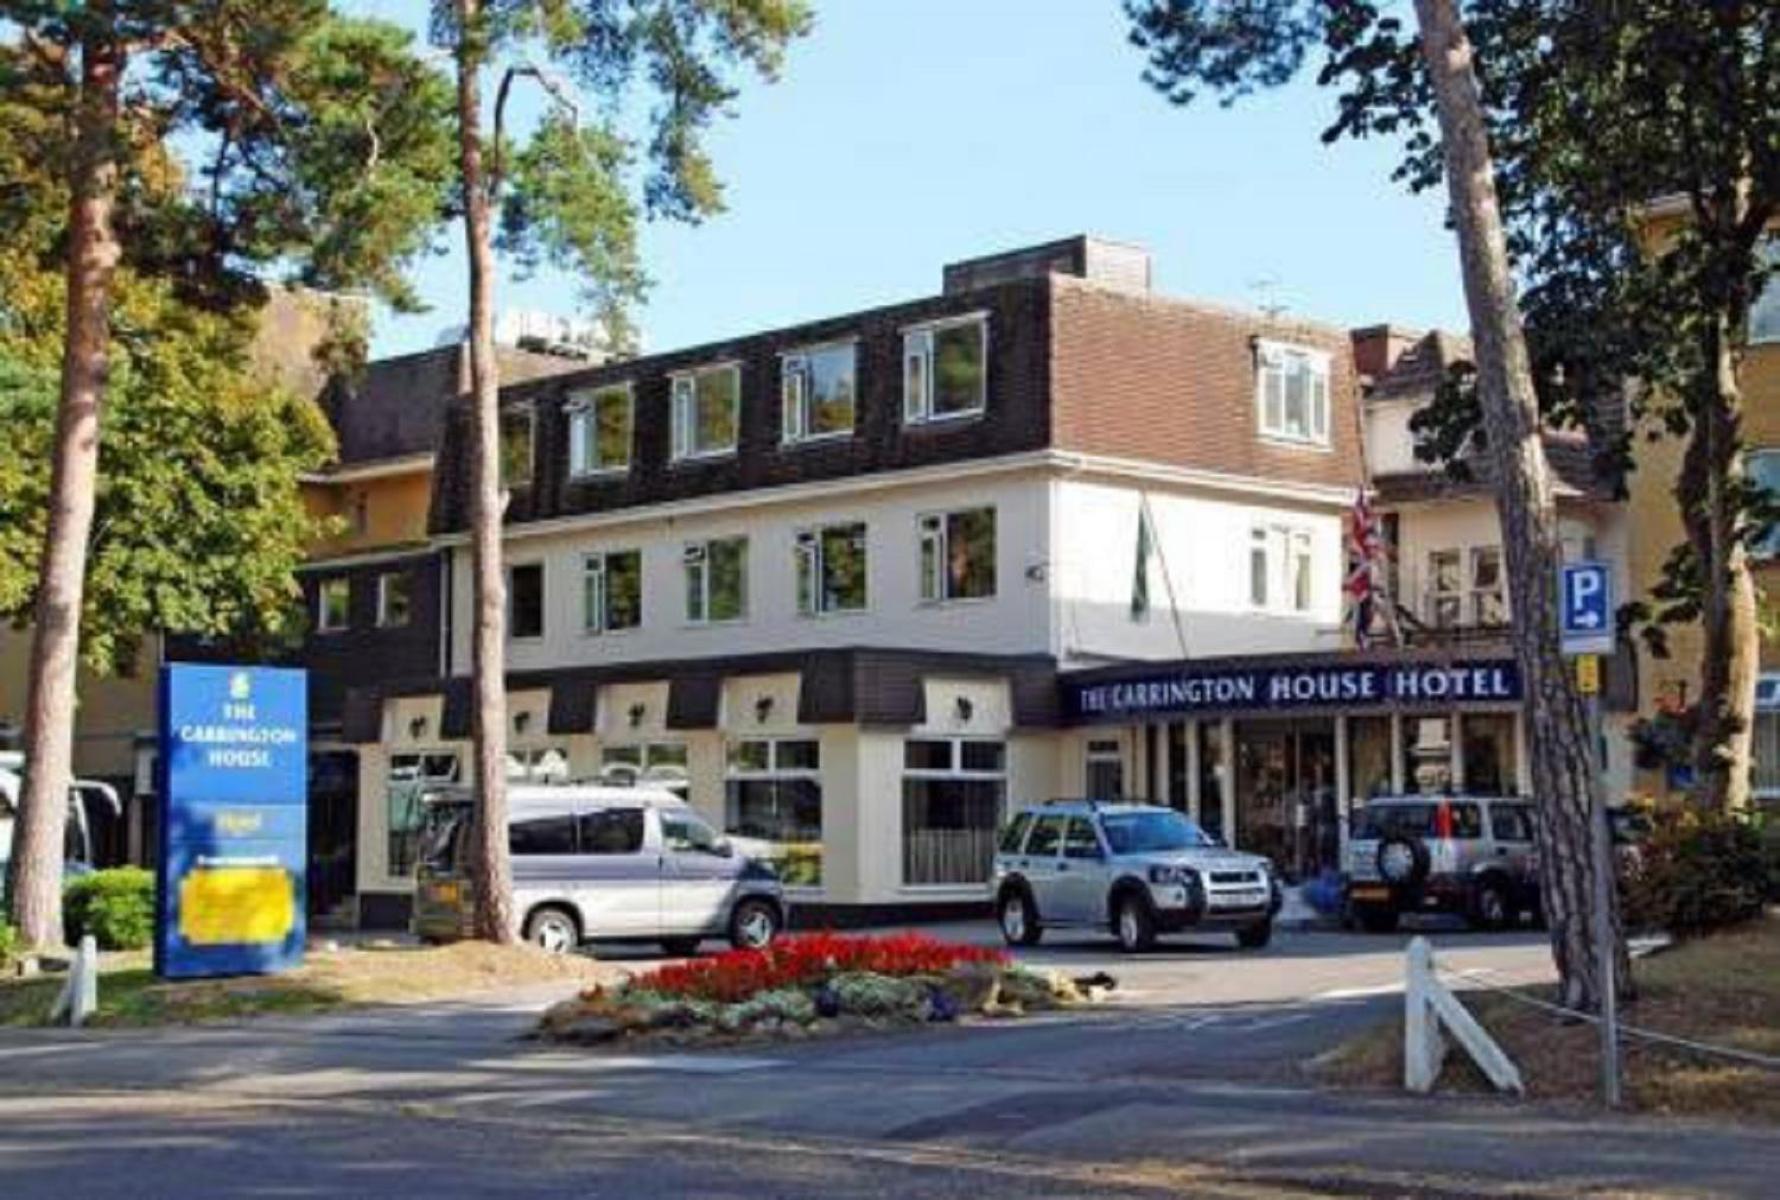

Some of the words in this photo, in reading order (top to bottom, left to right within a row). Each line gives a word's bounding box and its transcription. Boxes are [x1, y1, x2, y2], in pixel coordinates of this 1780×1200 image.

[1573, 569, 1600, 610] P
[1081, 689, 1106, 711] THE
[1113, 675, 1254, 708] CARRINGTON
[1270, 671, 1375, 700] HOUSE
[1396, 668, 1510, 697] HOTEL
[222, 702, 257, 719] THE
[181, 724, 297, 744] CARRINGTON
[208, 749, 270, 768] HOUSE
